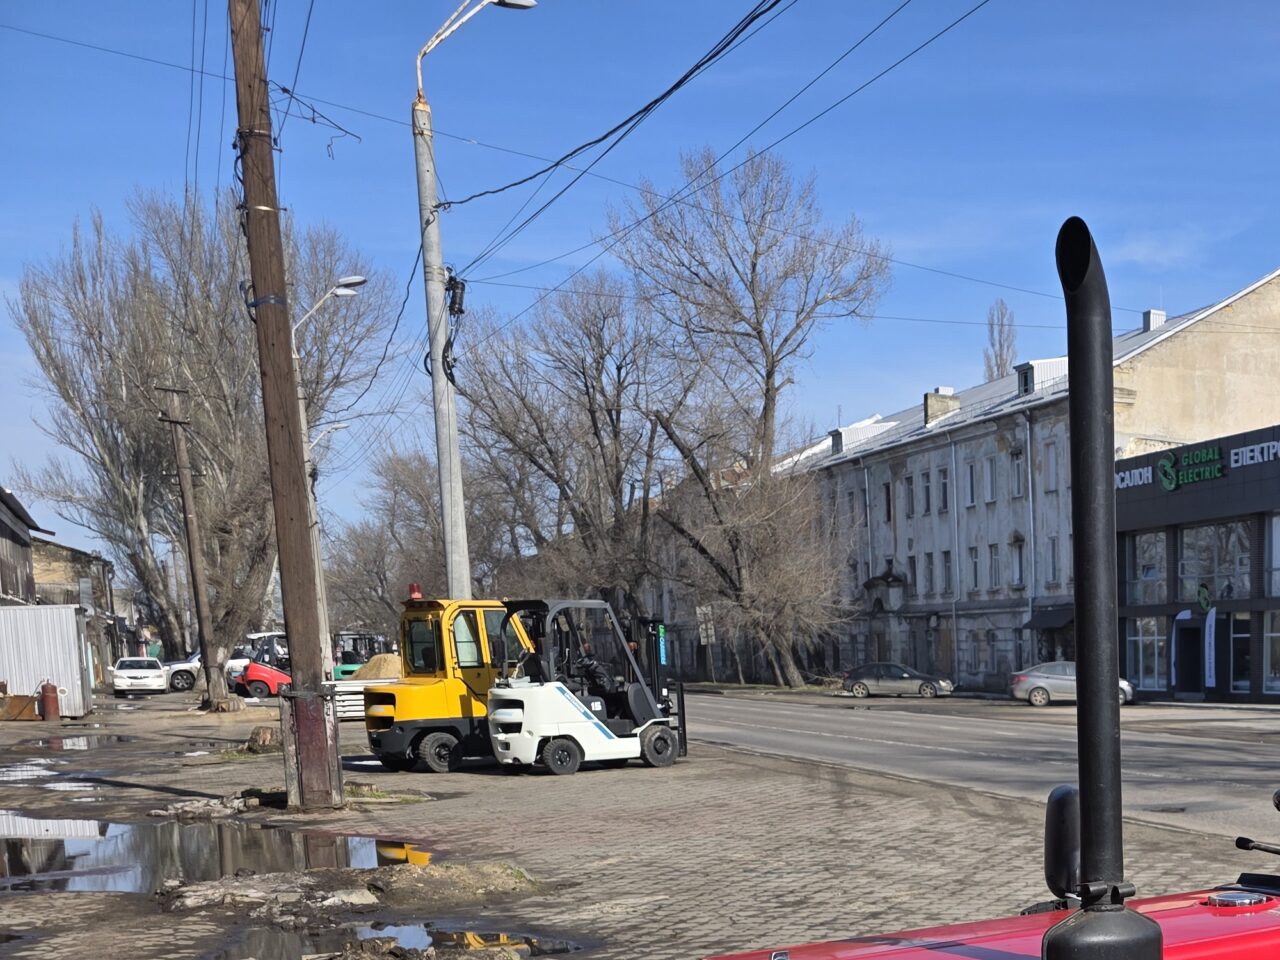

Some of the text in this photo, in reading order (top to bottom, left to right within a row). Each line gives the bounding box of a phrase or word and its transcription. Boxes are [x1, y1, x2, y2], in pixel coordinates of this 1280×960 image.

[1181, 447, 1220, 466] GLOBAL
[1178, 464, 1222, 484] ELECTRIC
[591, 701, 602, 711] 15
